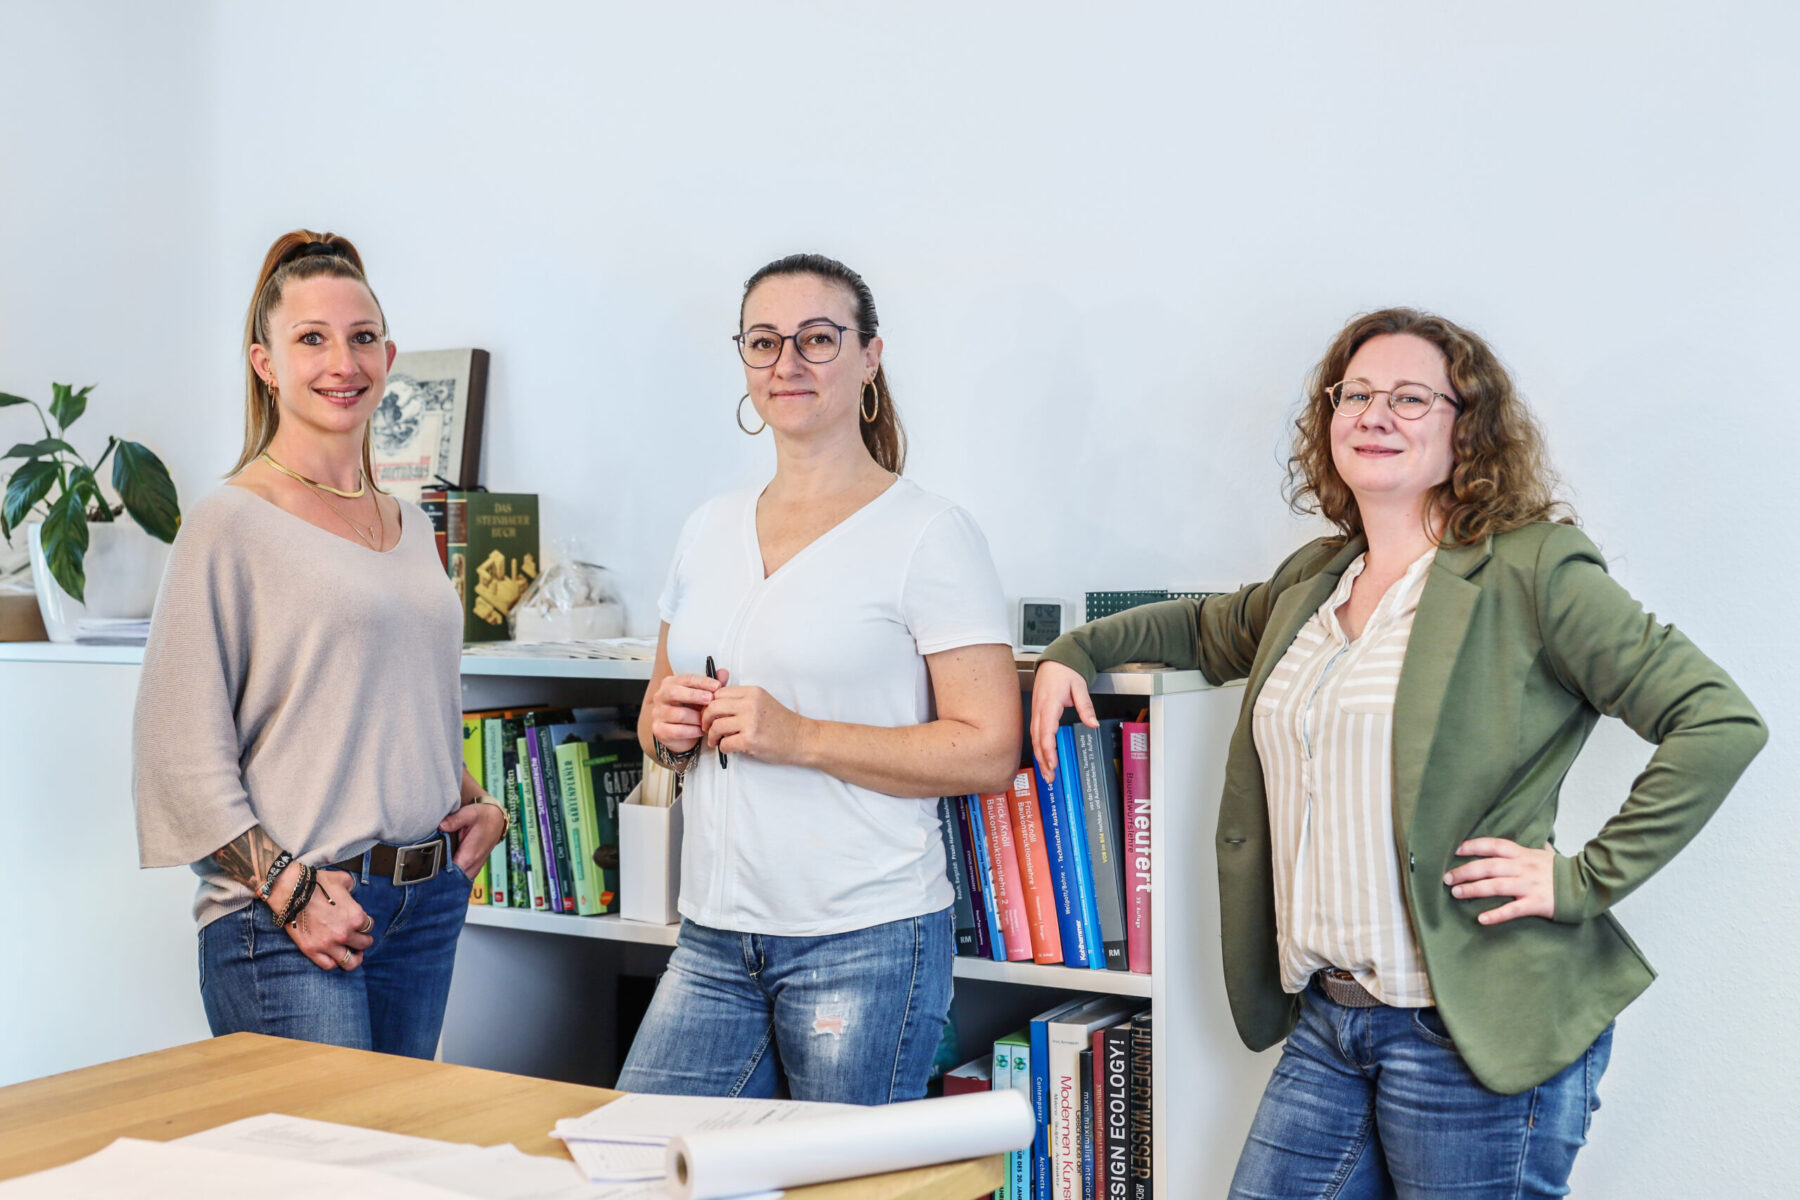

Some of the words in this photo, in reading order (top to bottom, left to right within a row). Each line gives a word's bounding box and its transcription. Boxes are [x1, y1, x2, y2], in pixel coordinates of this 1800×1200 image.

[491, 527, 517, 537] BUCH
[494, 503, 512, 513] DAS
[507, 769, 519, 827] Naturgarten
[531, 757, 546, 815] Schwimmteiche
[563, 760, 580, 823] GARTENPLANER
[1126, 772, 1135, 853] Bauentwurfslehre
[510, 829, 519, 854] Mein
[987, 799, 1006, 896] Baukonstruktionslehre
[1017, 801, 1034, 885] Baukonstruktionslehre
[1054, 828, 1063, 863] Technischer
[1134, 798, 1152, 893] Neufert
[959, 936, 972, 944] RM
[1076, 920, 1087, 961] Kohlhammer
[1108, 949, 1120, 957] RM
[1060, 1075, 1073, 1156] Modernen
[1109, 1039, 1126, 1140] ECOLOGY!
[1131, 1026, 1151, 1180] HUNDERTWASSER
[1083, 1117, 1092, 1162] maximalist
[1038, 1156, 1046, 1190] Architects
